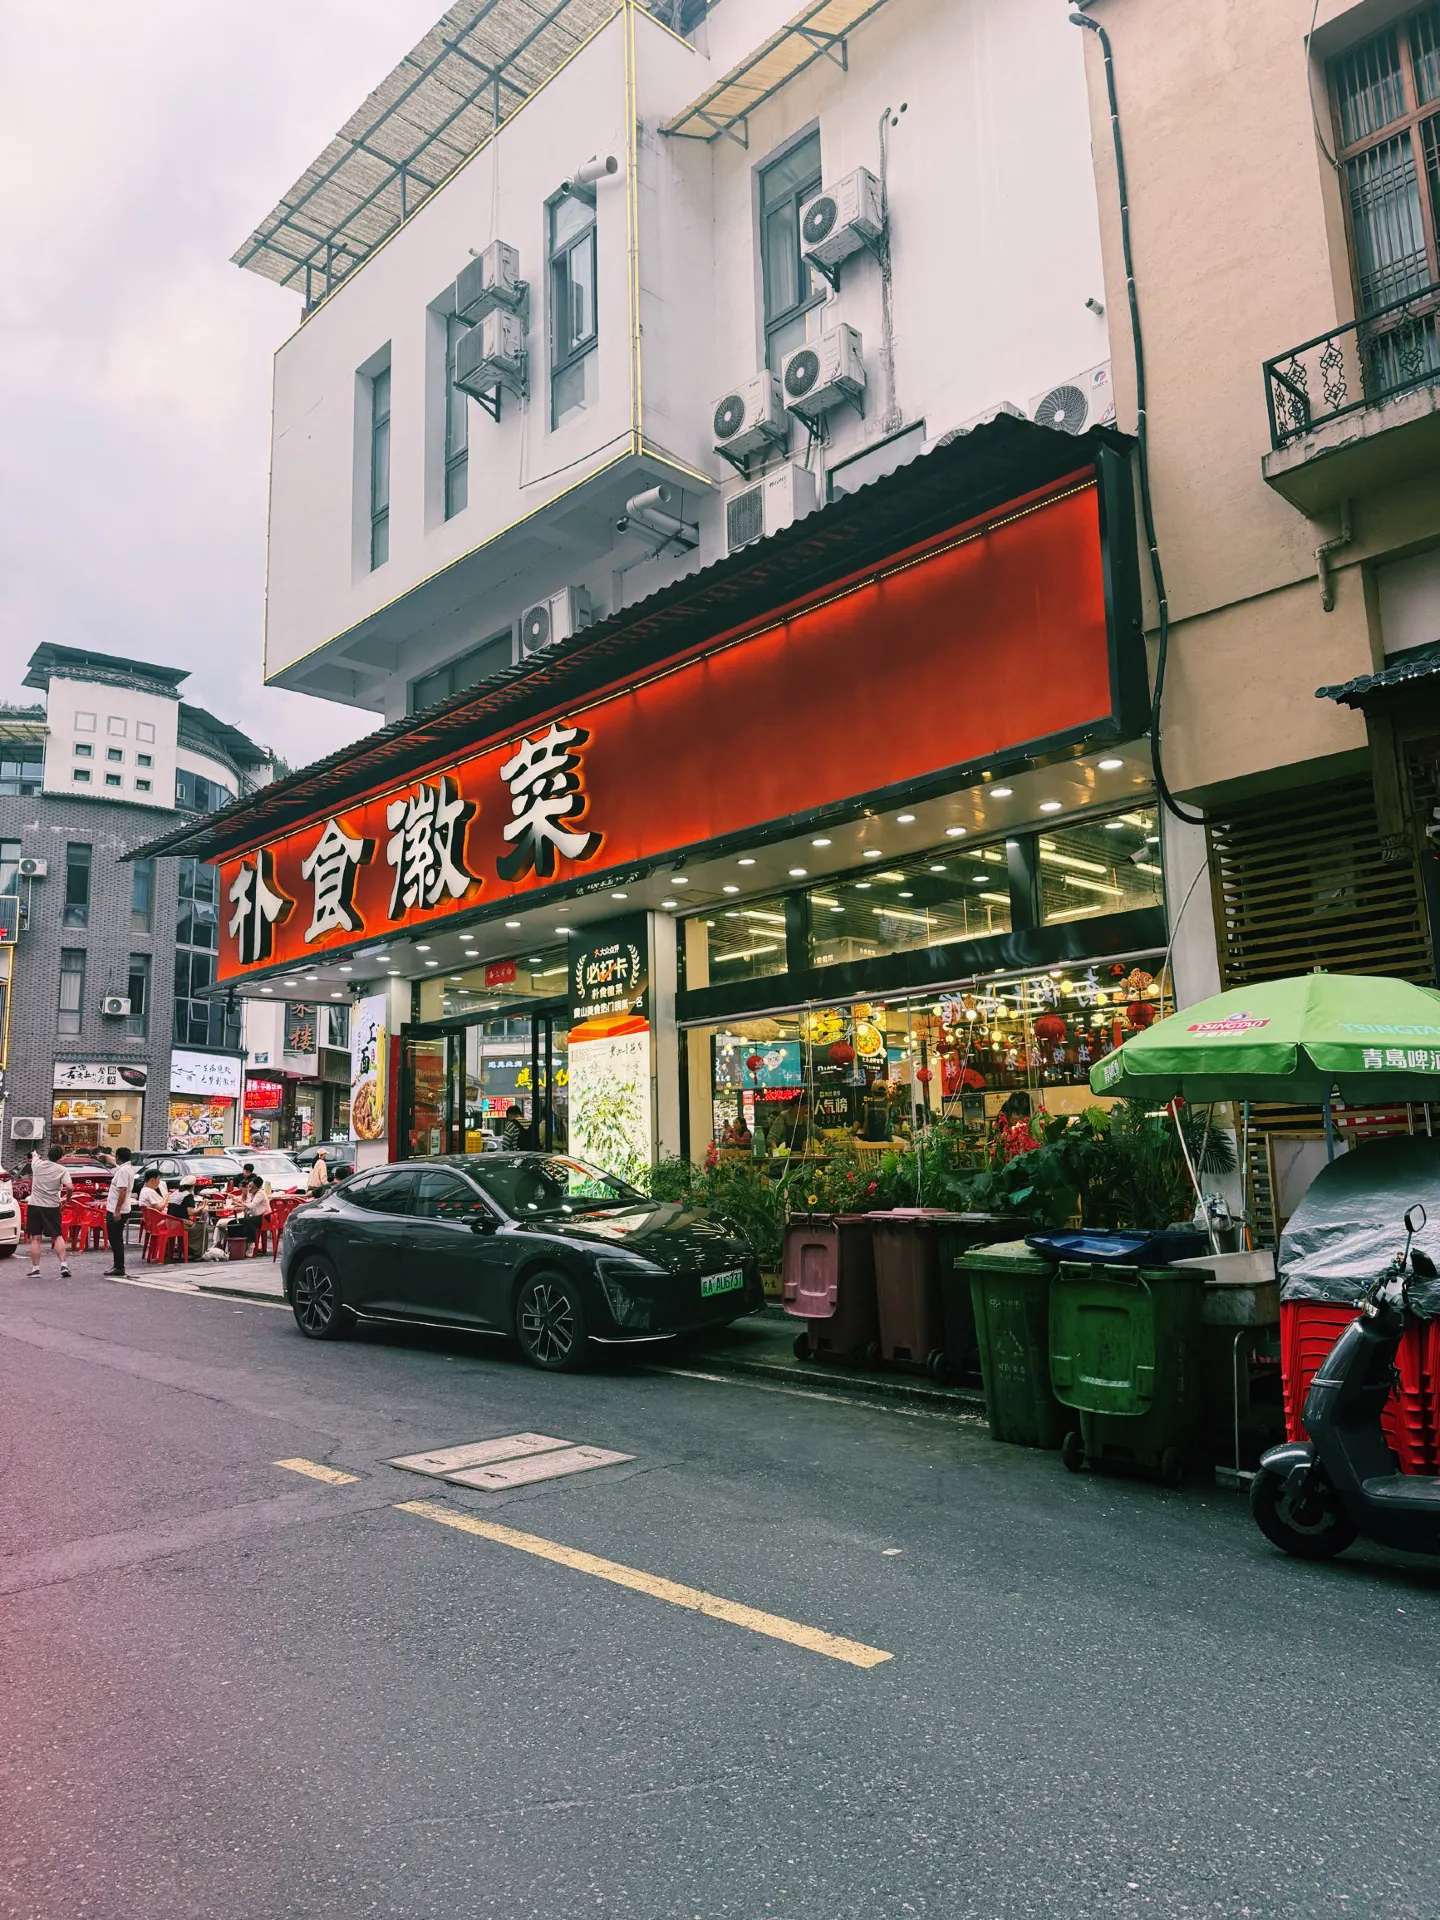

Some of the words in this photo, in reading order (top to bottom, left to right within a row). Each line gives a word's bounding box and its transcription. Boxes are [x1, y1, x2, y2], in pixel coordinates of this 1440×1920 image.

[228, 722, 602, 965] 朴食徽菜
[586, 957, 628, 985] 必打卡
[1196, 1020, 1264, 1032] TSINGTAO
[1338, 1022, 1440, 1036] TSINGTA
